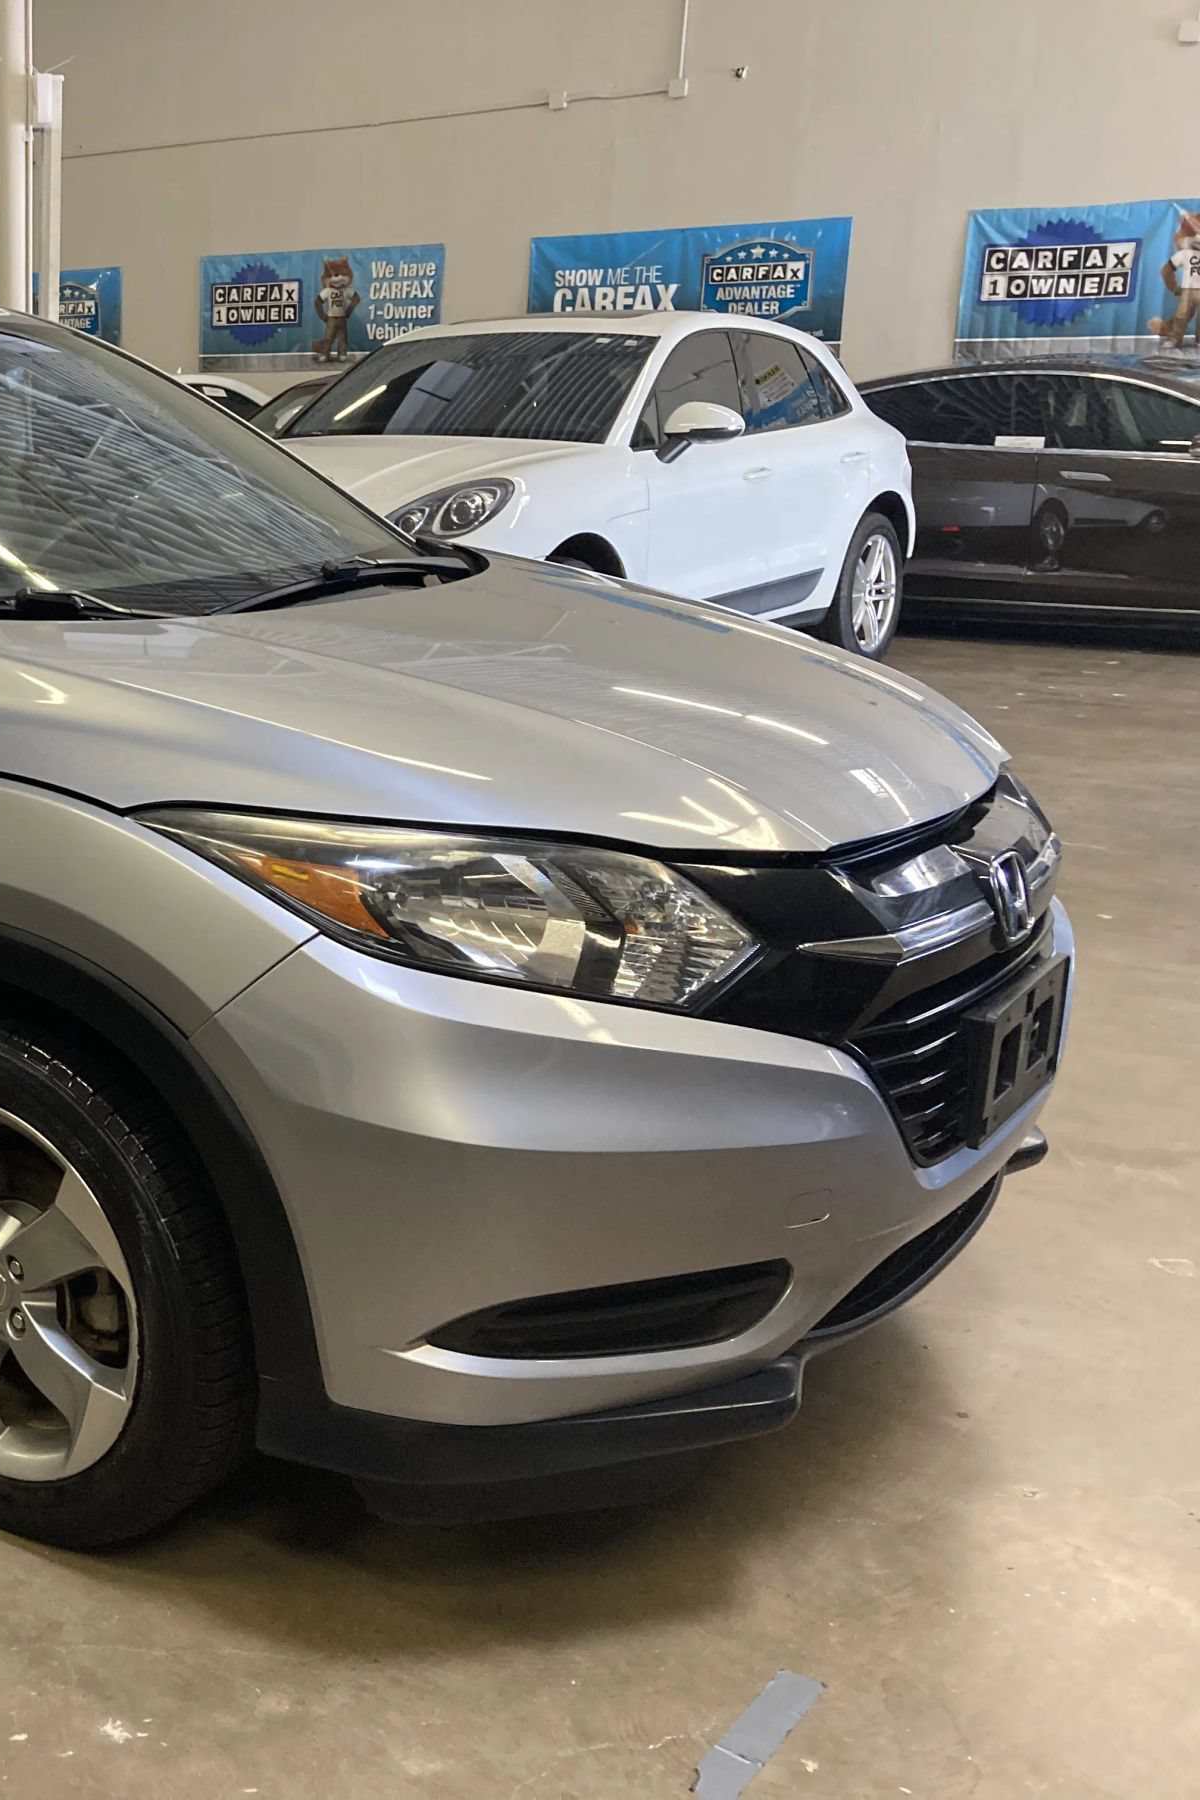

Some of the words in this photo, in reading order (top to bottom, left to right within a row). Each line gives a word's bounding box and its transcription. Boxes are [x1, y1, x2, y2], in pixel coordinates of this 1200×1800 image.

[990, 249, 1129, 270] CARFAX
[371, 261, 394, 279] We
[399, 260, 436, 278] have
[555, 269, 603, 287] SHOW
[606, 267, 630, 285] ME
[634, 265, 663, 284] THE
[711, 263, 800, 281] CARFAX
[215, 286, 296, 302] CARFAX
[369, 280, 434, 299] CARFAX
[716, 284, 795, 300] ADVANTAGE
[988, 280, 1001, 296] 1
[1009, 276, 1124, 295] OWNER
[553, 284, 678, 312] CARFAX
[59, 303, 93, 314] RFAX
[216, 309, 223, 322] 1
[228, 307, 295, 321] OWNER
[368, 303, 434, 320] 1-Owner
[728, 301, 779, 315] DEALER
[366, 323, 422, 340] Vehicl
